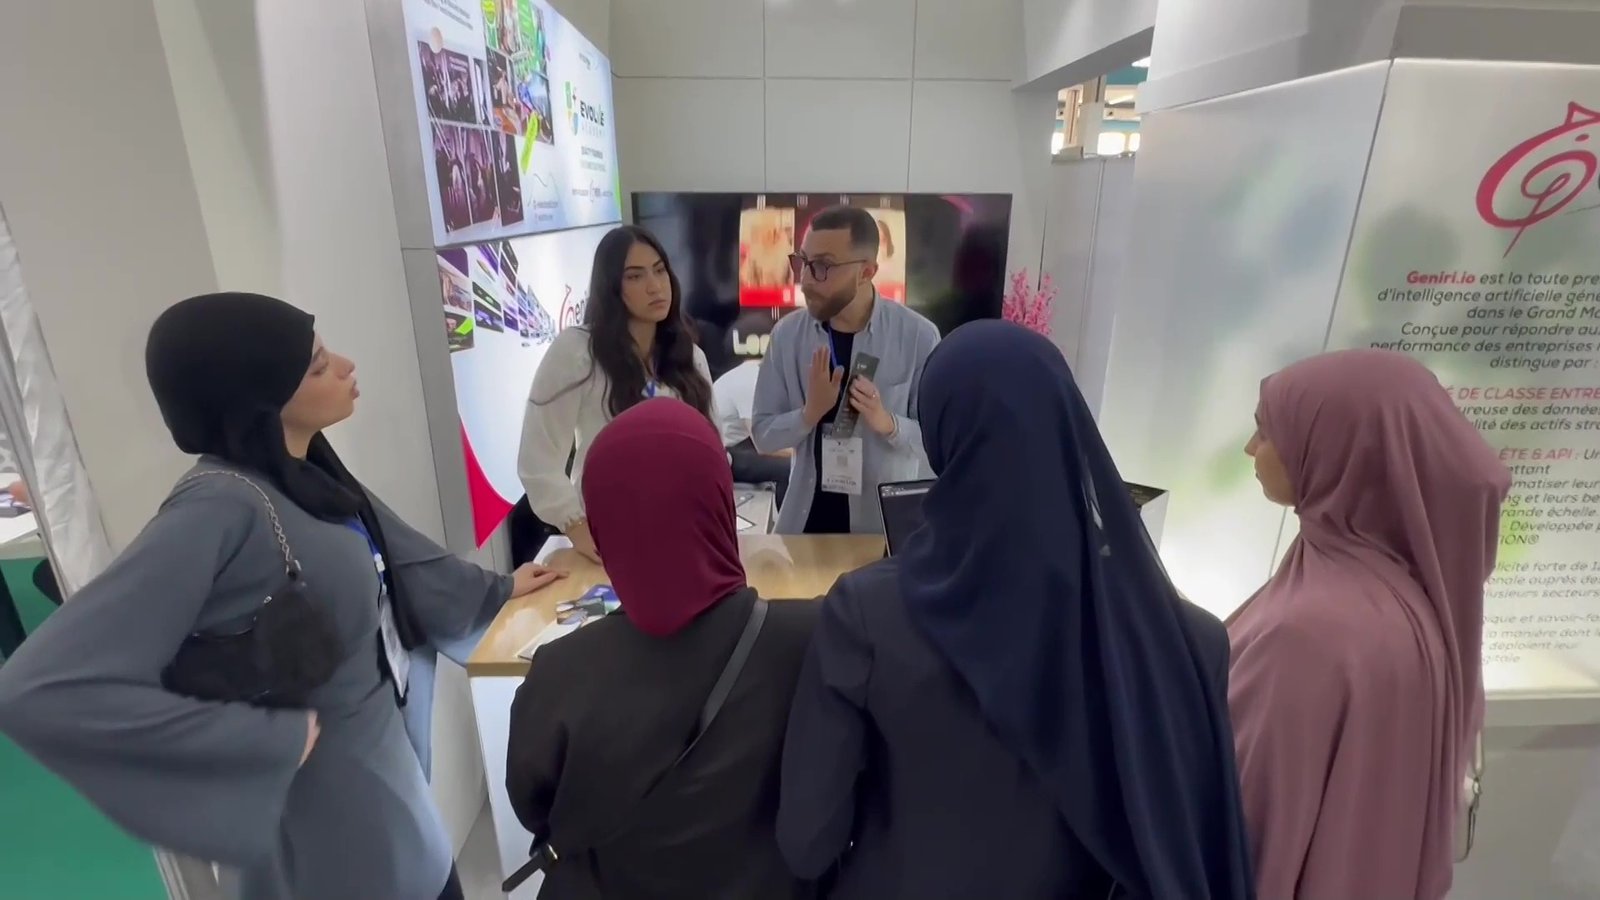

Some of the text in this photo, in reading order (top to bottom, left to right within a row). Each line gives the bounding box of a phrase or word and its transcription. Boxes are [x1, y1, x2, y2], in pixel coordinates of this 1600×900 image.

[1406, 270, 1476, 285] Geniri.io
[1480, 273, 1504, 285] est
[1508, 272, 1522, 285] la
[1528, 273, 1569, 285] toute
[1378, 288, 1481, 307] d'intelligence
[1485, 289, 1562, 302] artificielle
[1467, 306, 1505, 319] dans
[1509, 306, 1523, 319] le
[1527, 305, 1577, 319] Grand
[1401, 322, 1459, 339] Conçue
[1461, 325, 1499, 338] pour
[1502, 323, 1574, 338] répondre
[1474, 340, 1501, 352] des
[1505, 341, 1592, 355] entreprises
[1489, 356, 1560, 372] distingue
[1563, 359, 1591, 371] par
[1458, 387, 1481, 400] DE
[1484, 387, 1547, 400] CLASSE
[1512, 403, 1538, 415] des
[1500, 418, 1526, 430] des
[1530, 418, 1572, 430] actifs
[1544, 448, 1574, 460] API
[1525, 494, 1540, 504] et
[1543, 493, 1578, 504] leurs
